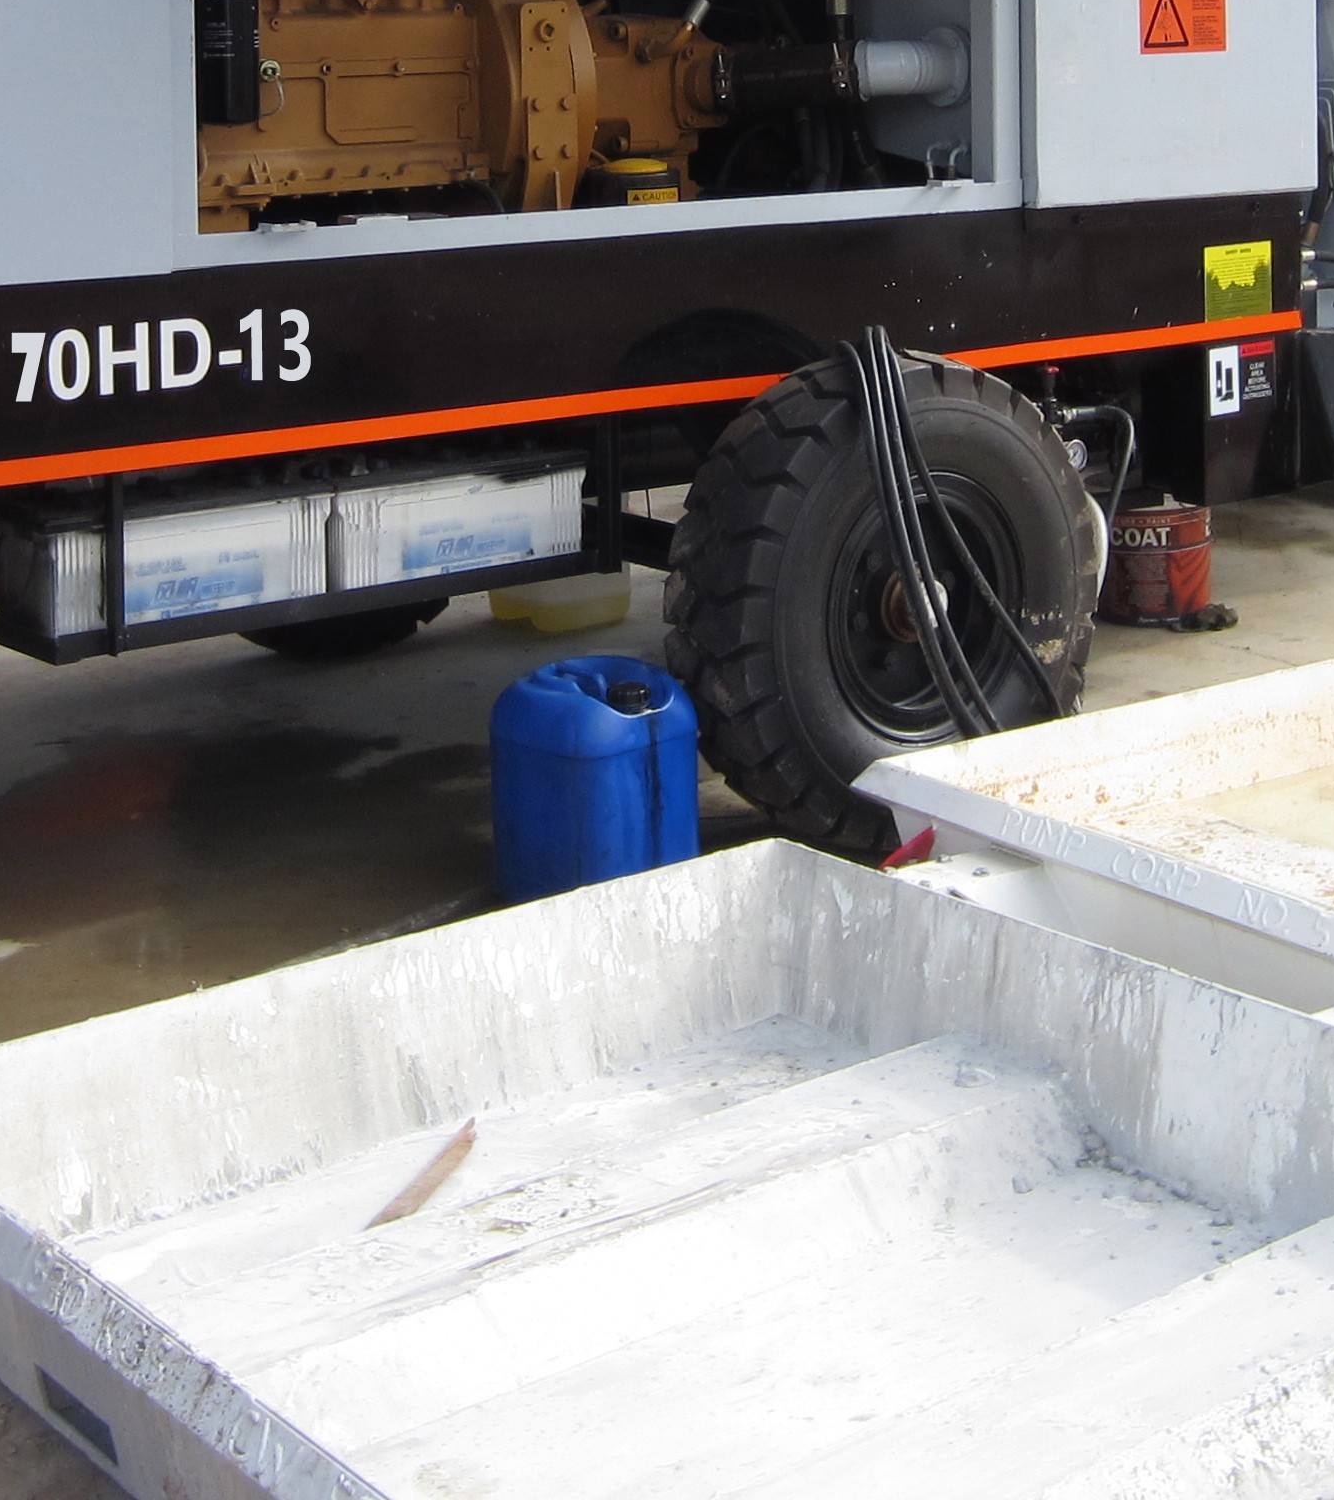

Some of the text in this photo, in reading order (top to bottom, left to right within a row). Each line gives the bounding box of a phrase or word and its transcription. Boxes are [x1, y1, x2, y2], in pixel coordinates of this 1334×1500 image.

[11, 308, 311, 402] 70HD-13
[1111, 527, 1171, 547] COAT
[1000, 808, 1087, 858] PUMP
[1112, 848, 1201, 897] CORP
